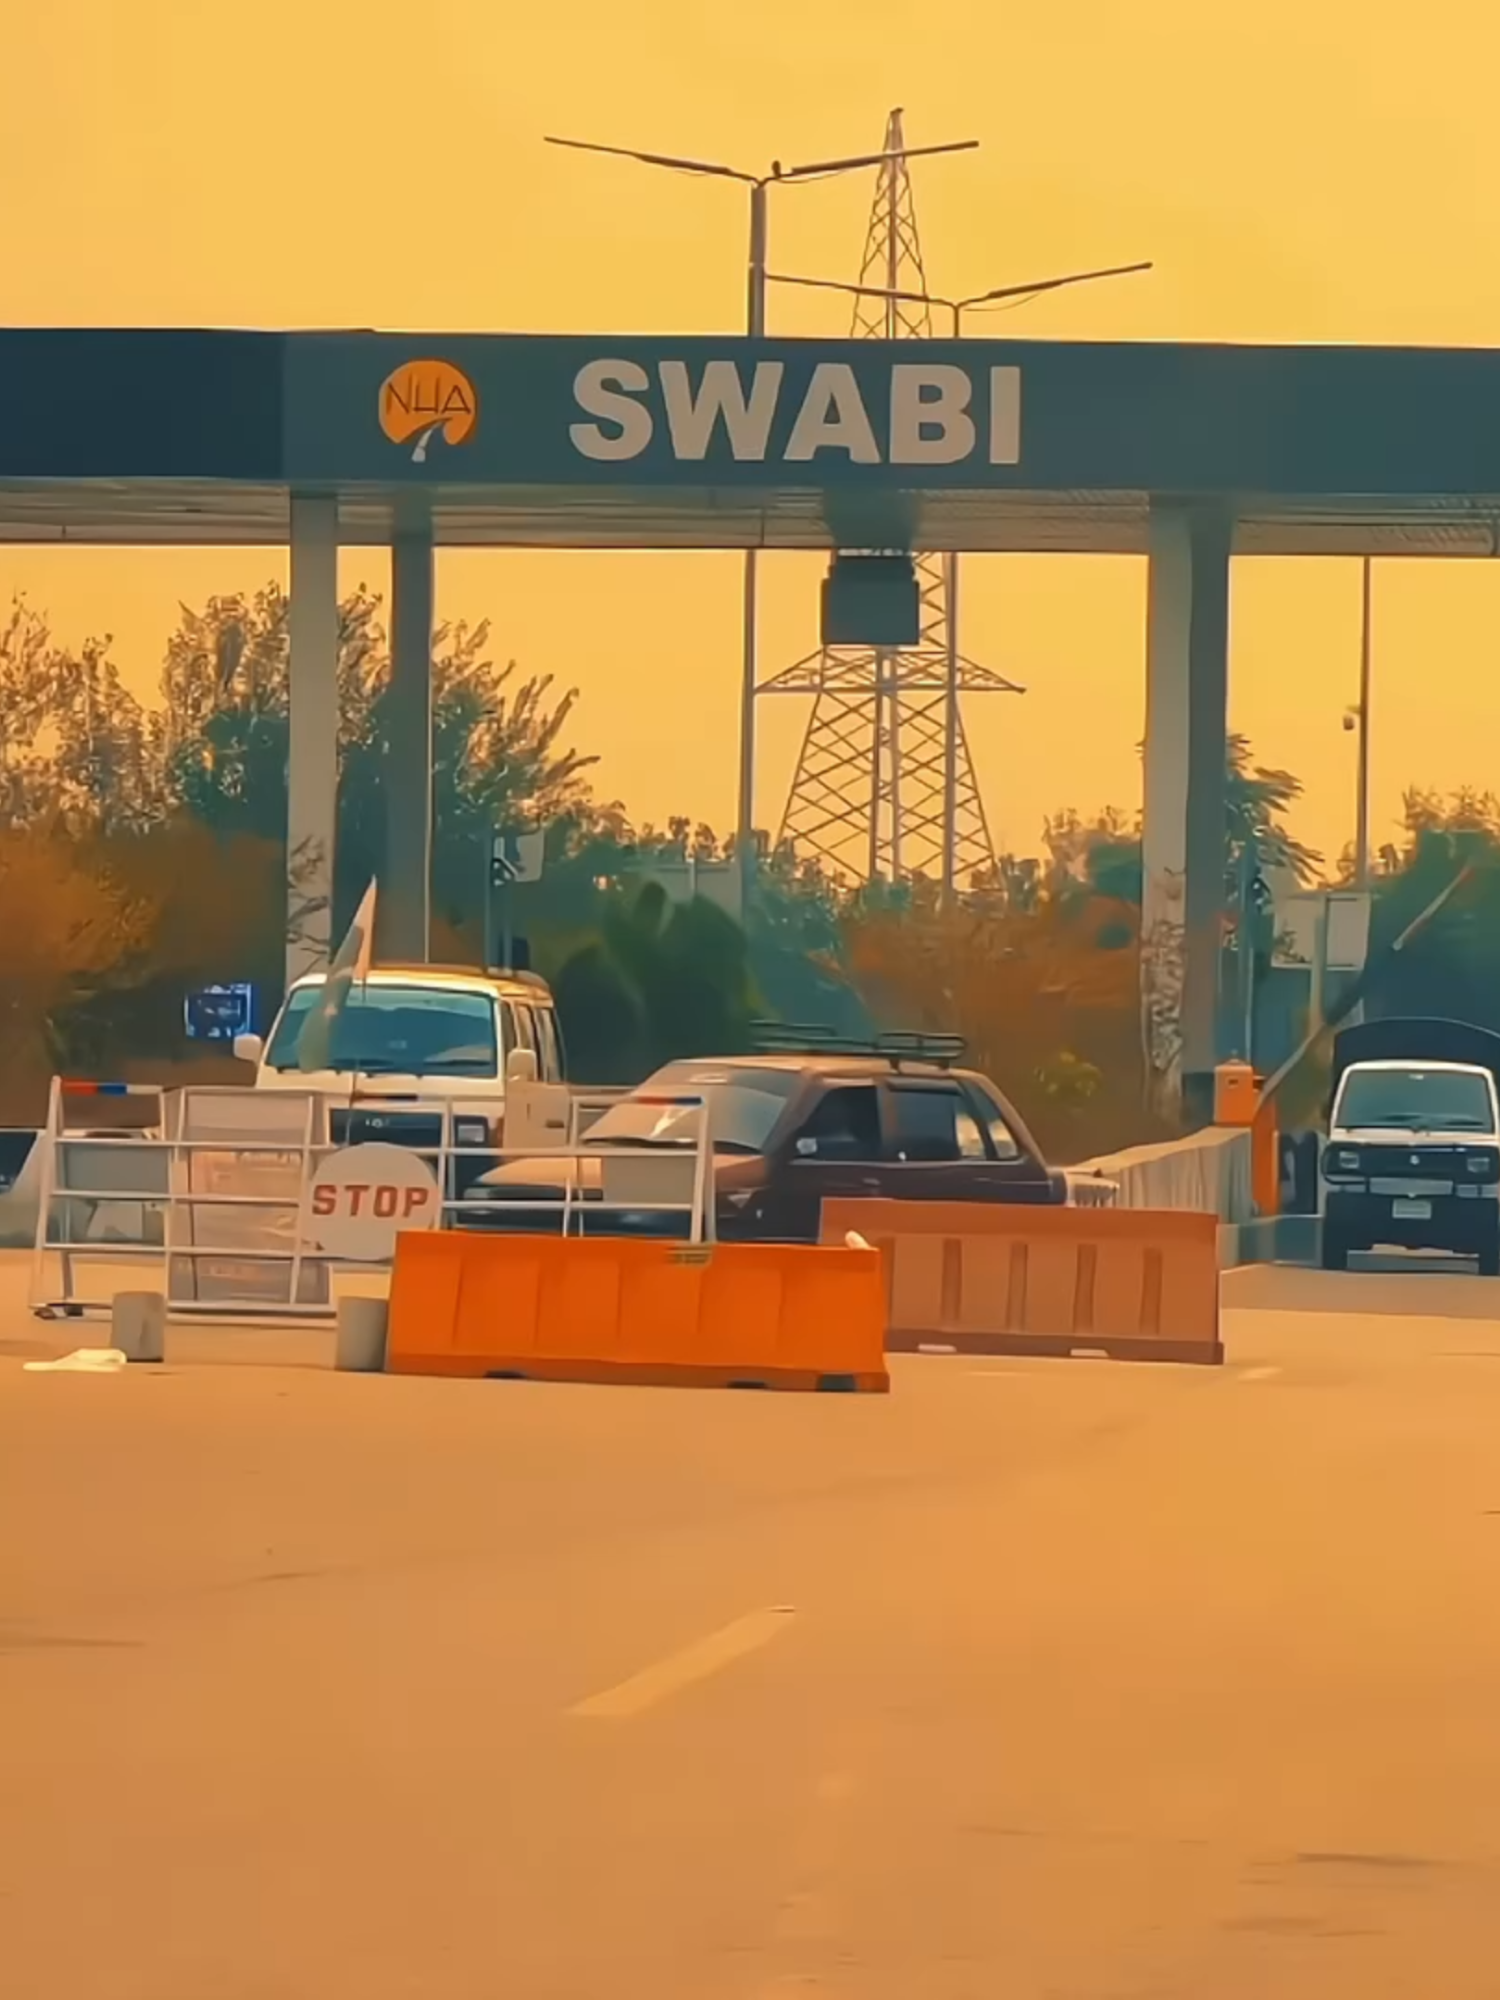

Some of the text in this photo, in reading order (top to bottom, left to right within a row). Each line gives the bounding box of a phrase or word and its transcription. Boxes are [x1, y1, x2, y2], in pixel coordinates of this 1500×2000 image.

[385, 373, 472, 414] NHA
[569, 358, 1021, 465] SWABI
[312, 1184, 429, 1218] STOP
